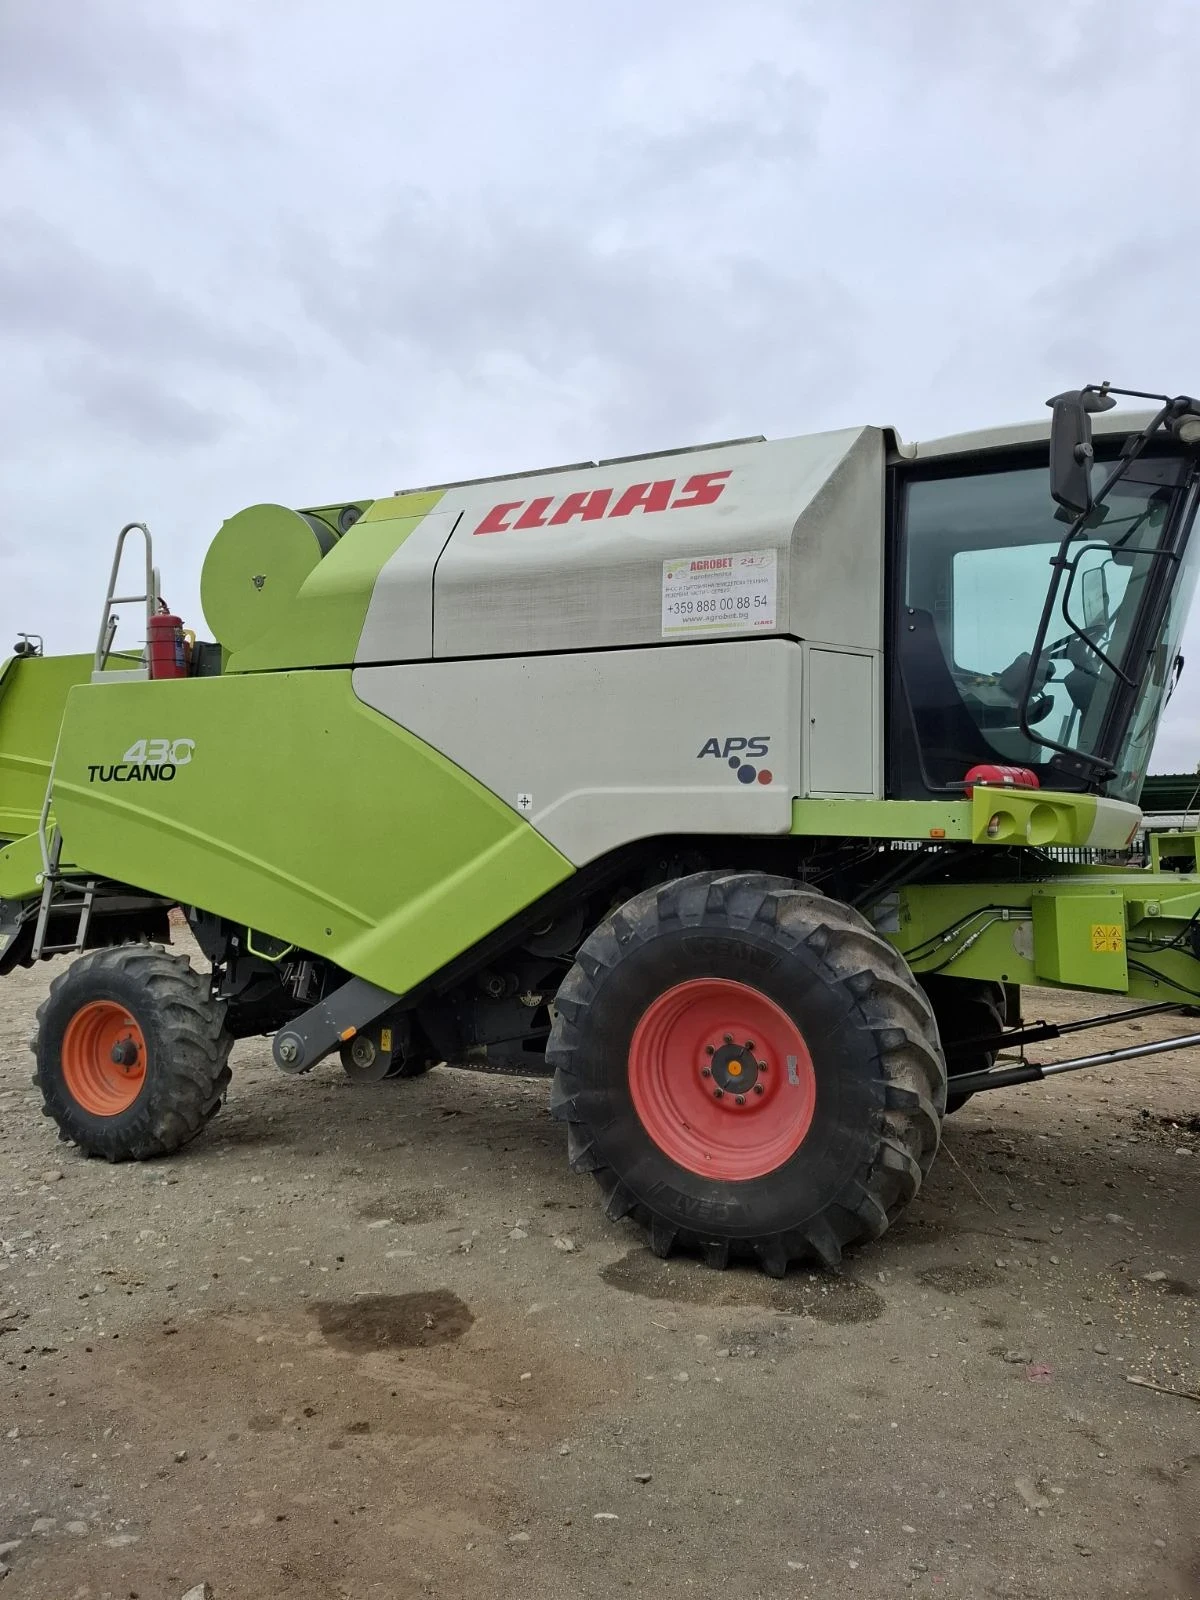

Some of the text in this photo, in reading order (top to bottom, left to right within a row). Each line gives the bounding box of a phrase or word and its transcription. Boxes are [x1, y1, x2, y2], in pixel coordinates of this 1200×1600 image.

[473, 470, 733, 535] CLAAS
[690, 557, 733, 571] AGROBET
[667, 595, 767, 614] +359 888 00 88 54
[682, 612, 749, 623] www.agrobet.bg
[123, 738, 195, 765] 430
[696, 736, 770, 758] APS
[88, 764, 176, 782] TUCANO
